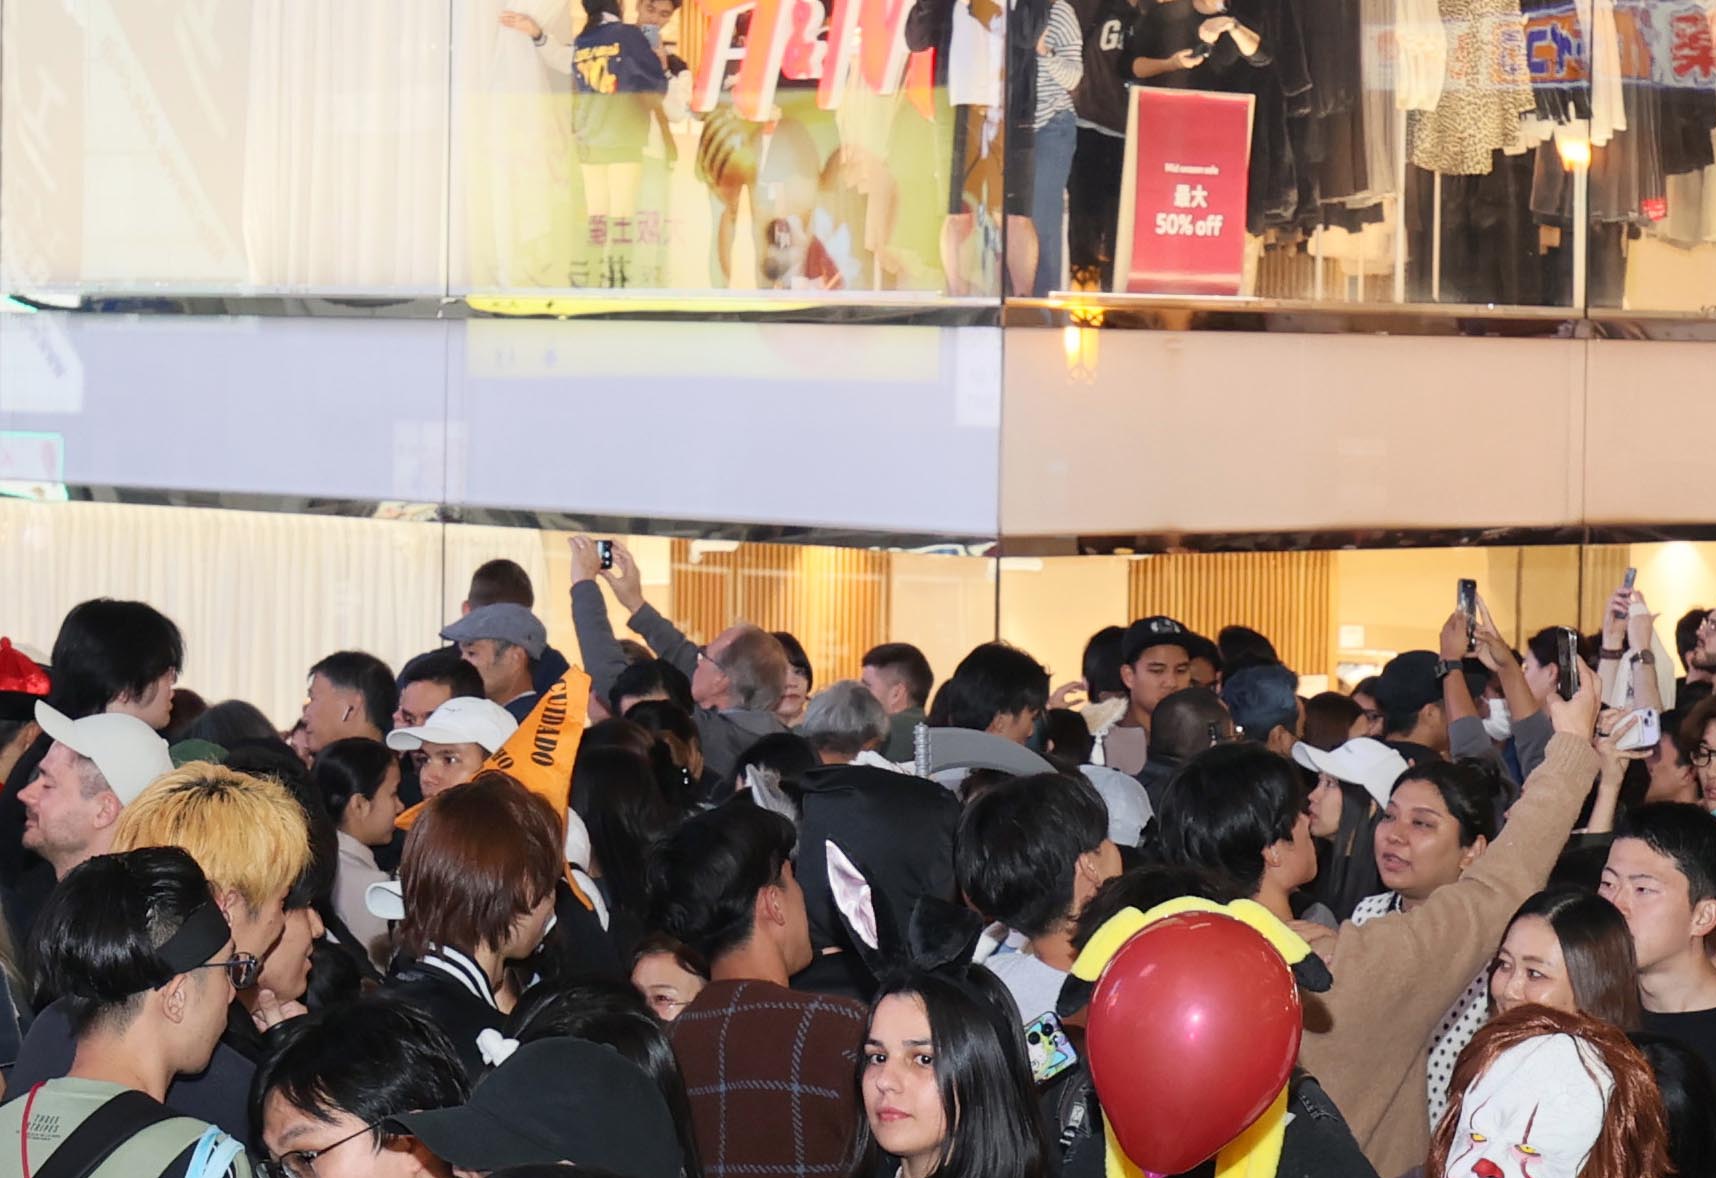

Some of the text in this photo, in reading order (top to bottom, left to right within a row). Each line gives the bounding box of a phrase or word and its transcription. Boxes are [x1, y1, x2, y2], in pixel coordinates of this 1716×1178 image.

[1174, 184, 1208, 208] 最大
[1155, 212, 1224, 237] 50% off
[530, 678, 567, 767] CUIDADO
